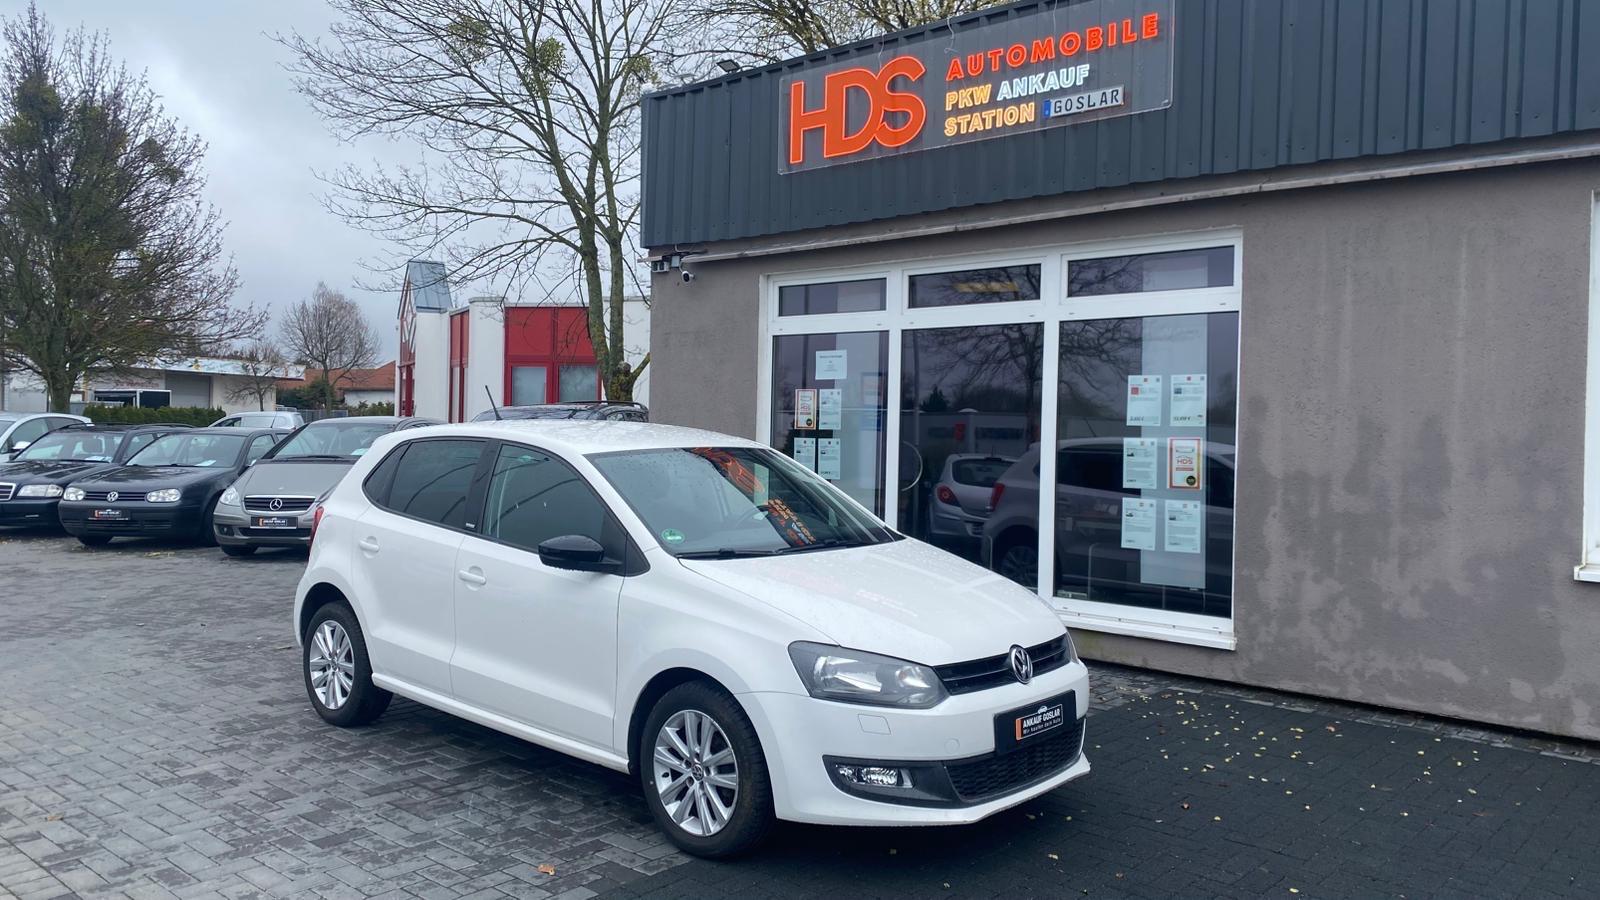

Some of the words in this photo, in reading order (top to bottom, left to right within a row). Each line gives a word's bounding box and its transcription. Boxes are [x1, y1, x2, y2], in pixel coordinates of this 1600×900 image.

[946, 12, 1159, 81] AUTOMOBILE
[945, 84, 992, 111] PKW
[997, 64, 1090, 101] ANKAUF
[1053, 88, 1120, 115] GOSLAR
[790, 56, 926, 164] HDS
[944, 102, 1035, 137] STATION
[1023, 715, 1042, 728] ANKAUF
[1043, 708, 1060, 721] GOSLAR
